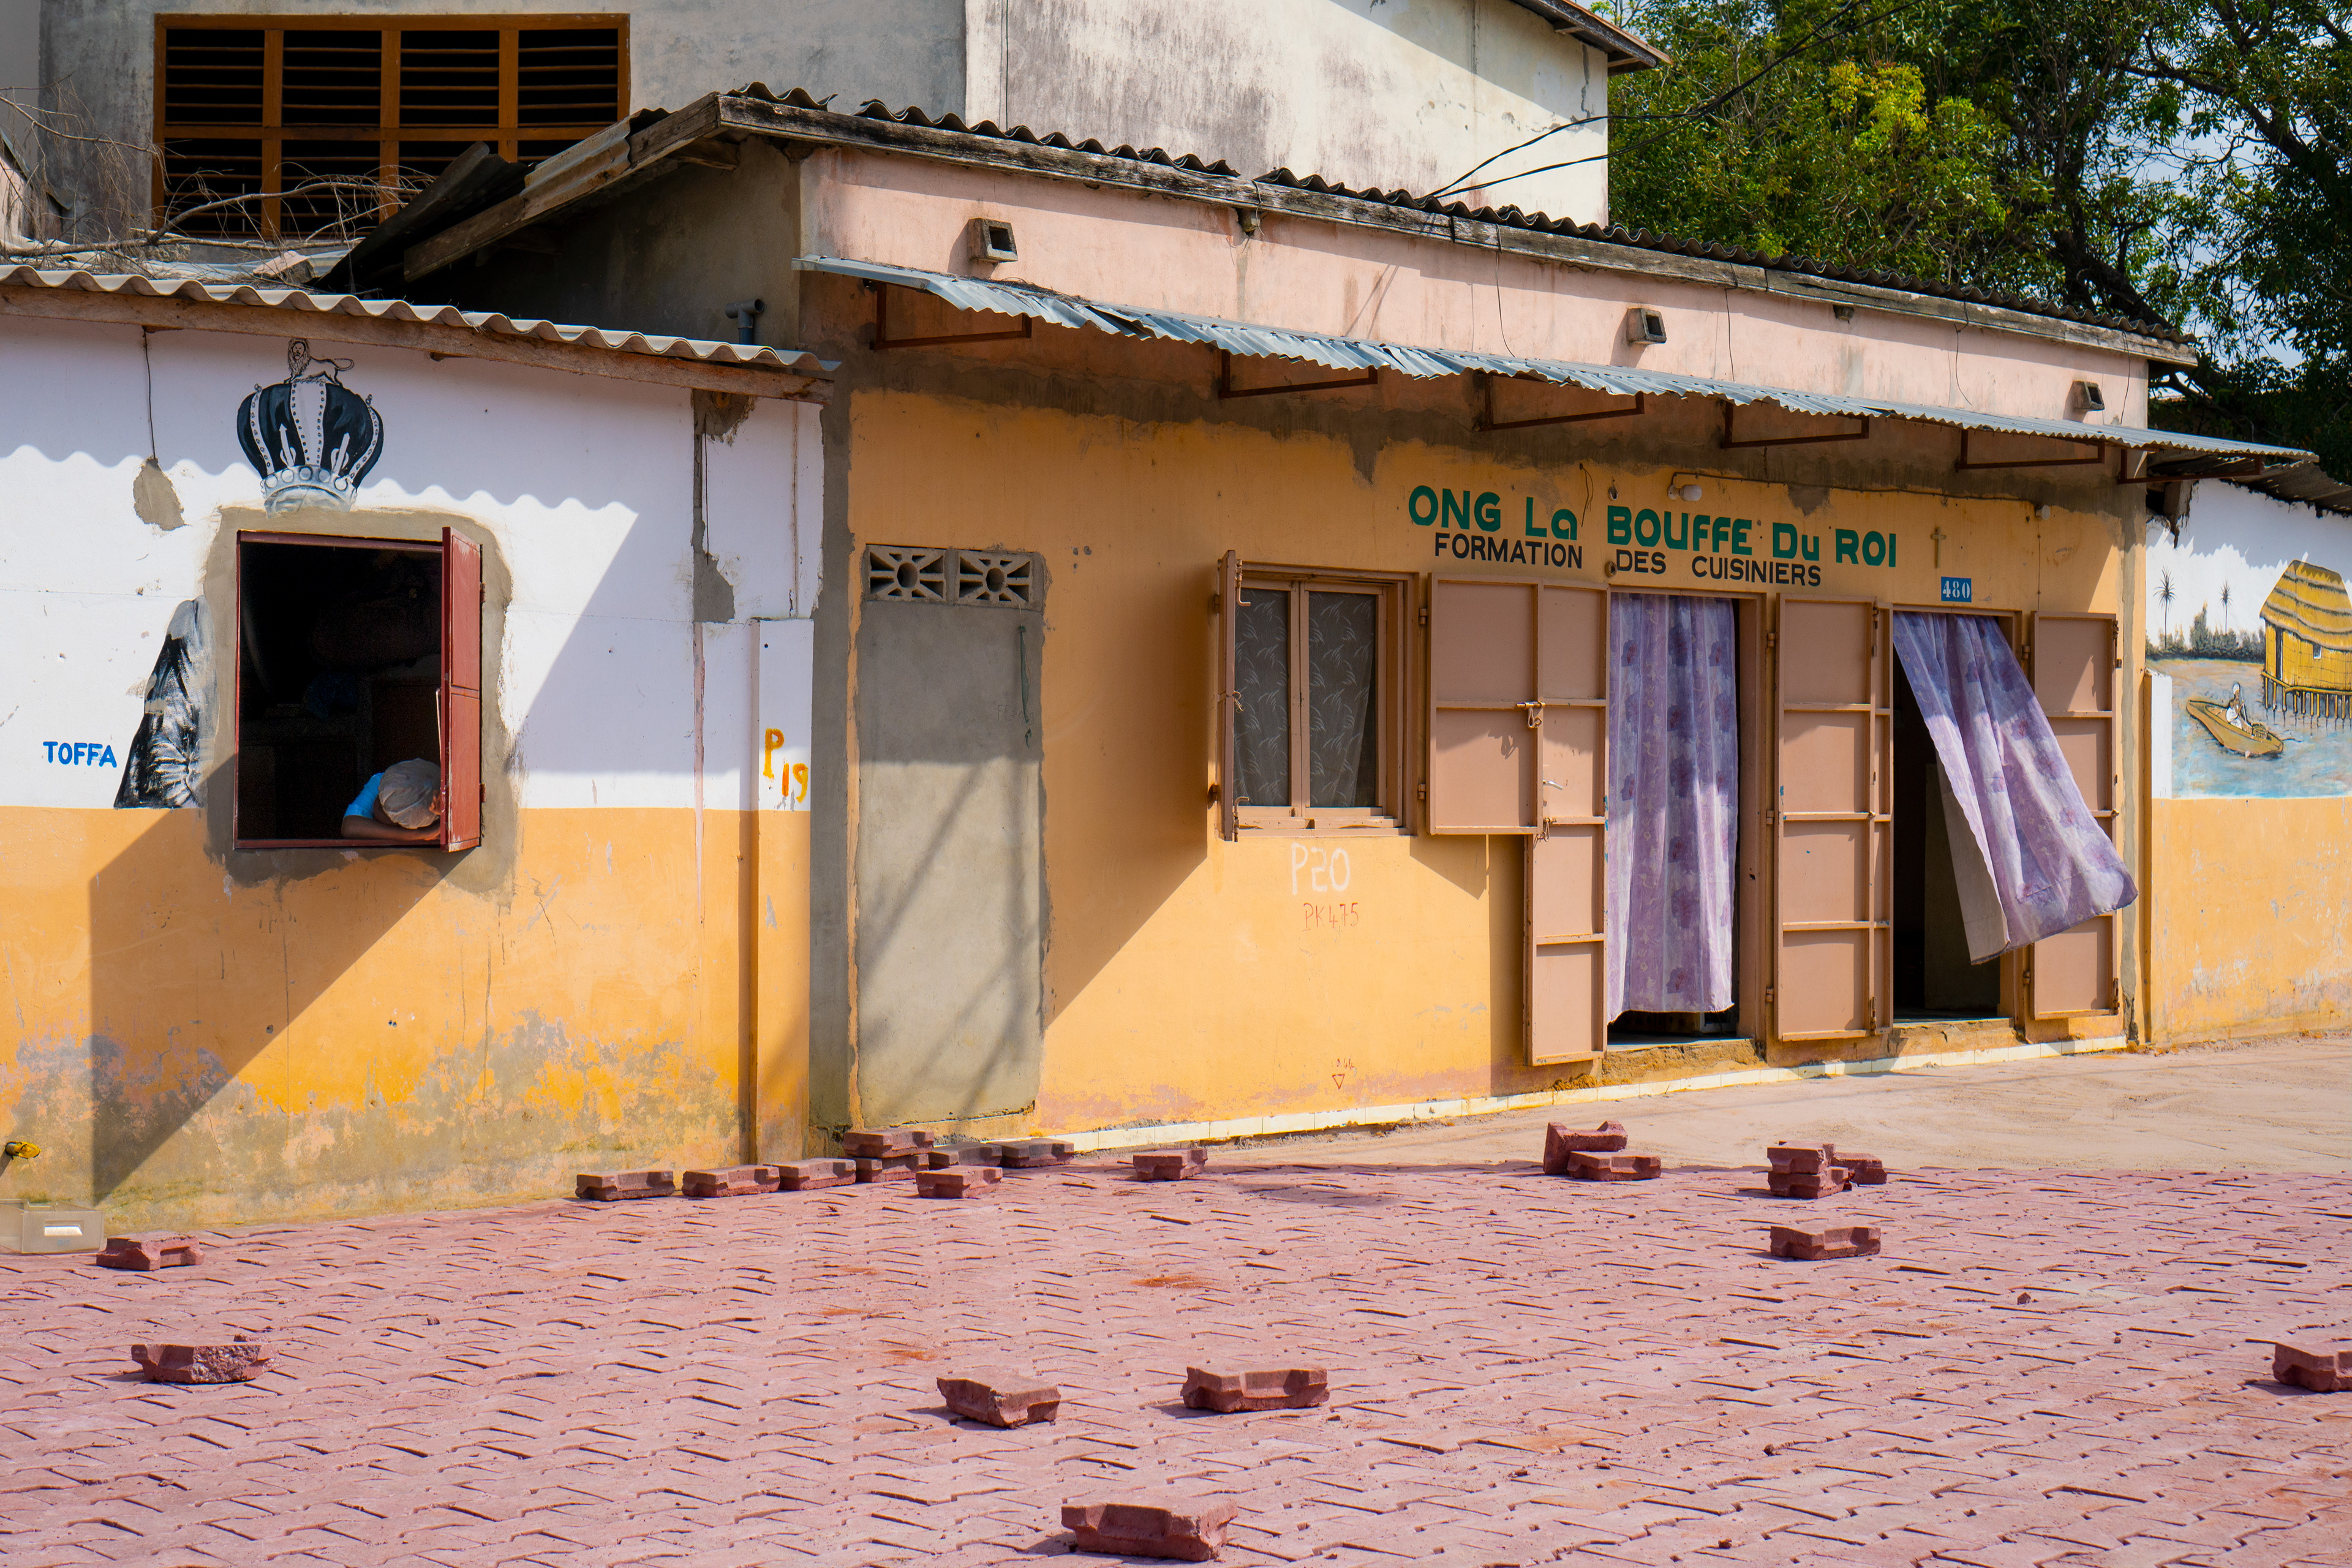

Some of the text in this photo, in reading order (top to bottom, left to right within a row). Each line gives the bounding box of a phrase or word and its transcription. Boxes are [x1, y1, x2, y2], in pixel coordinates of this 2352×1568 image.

[1409, 486, 1897, 568] ONG La BOUFFE Du ROI
[1434, 532, 1822, 587] FORMATION DES CUISINIERS
[1942, 580, 1970, 599] 480
[42, 741, 118, 769] TOFFA
[1290, 841, 1351, 895] P20
